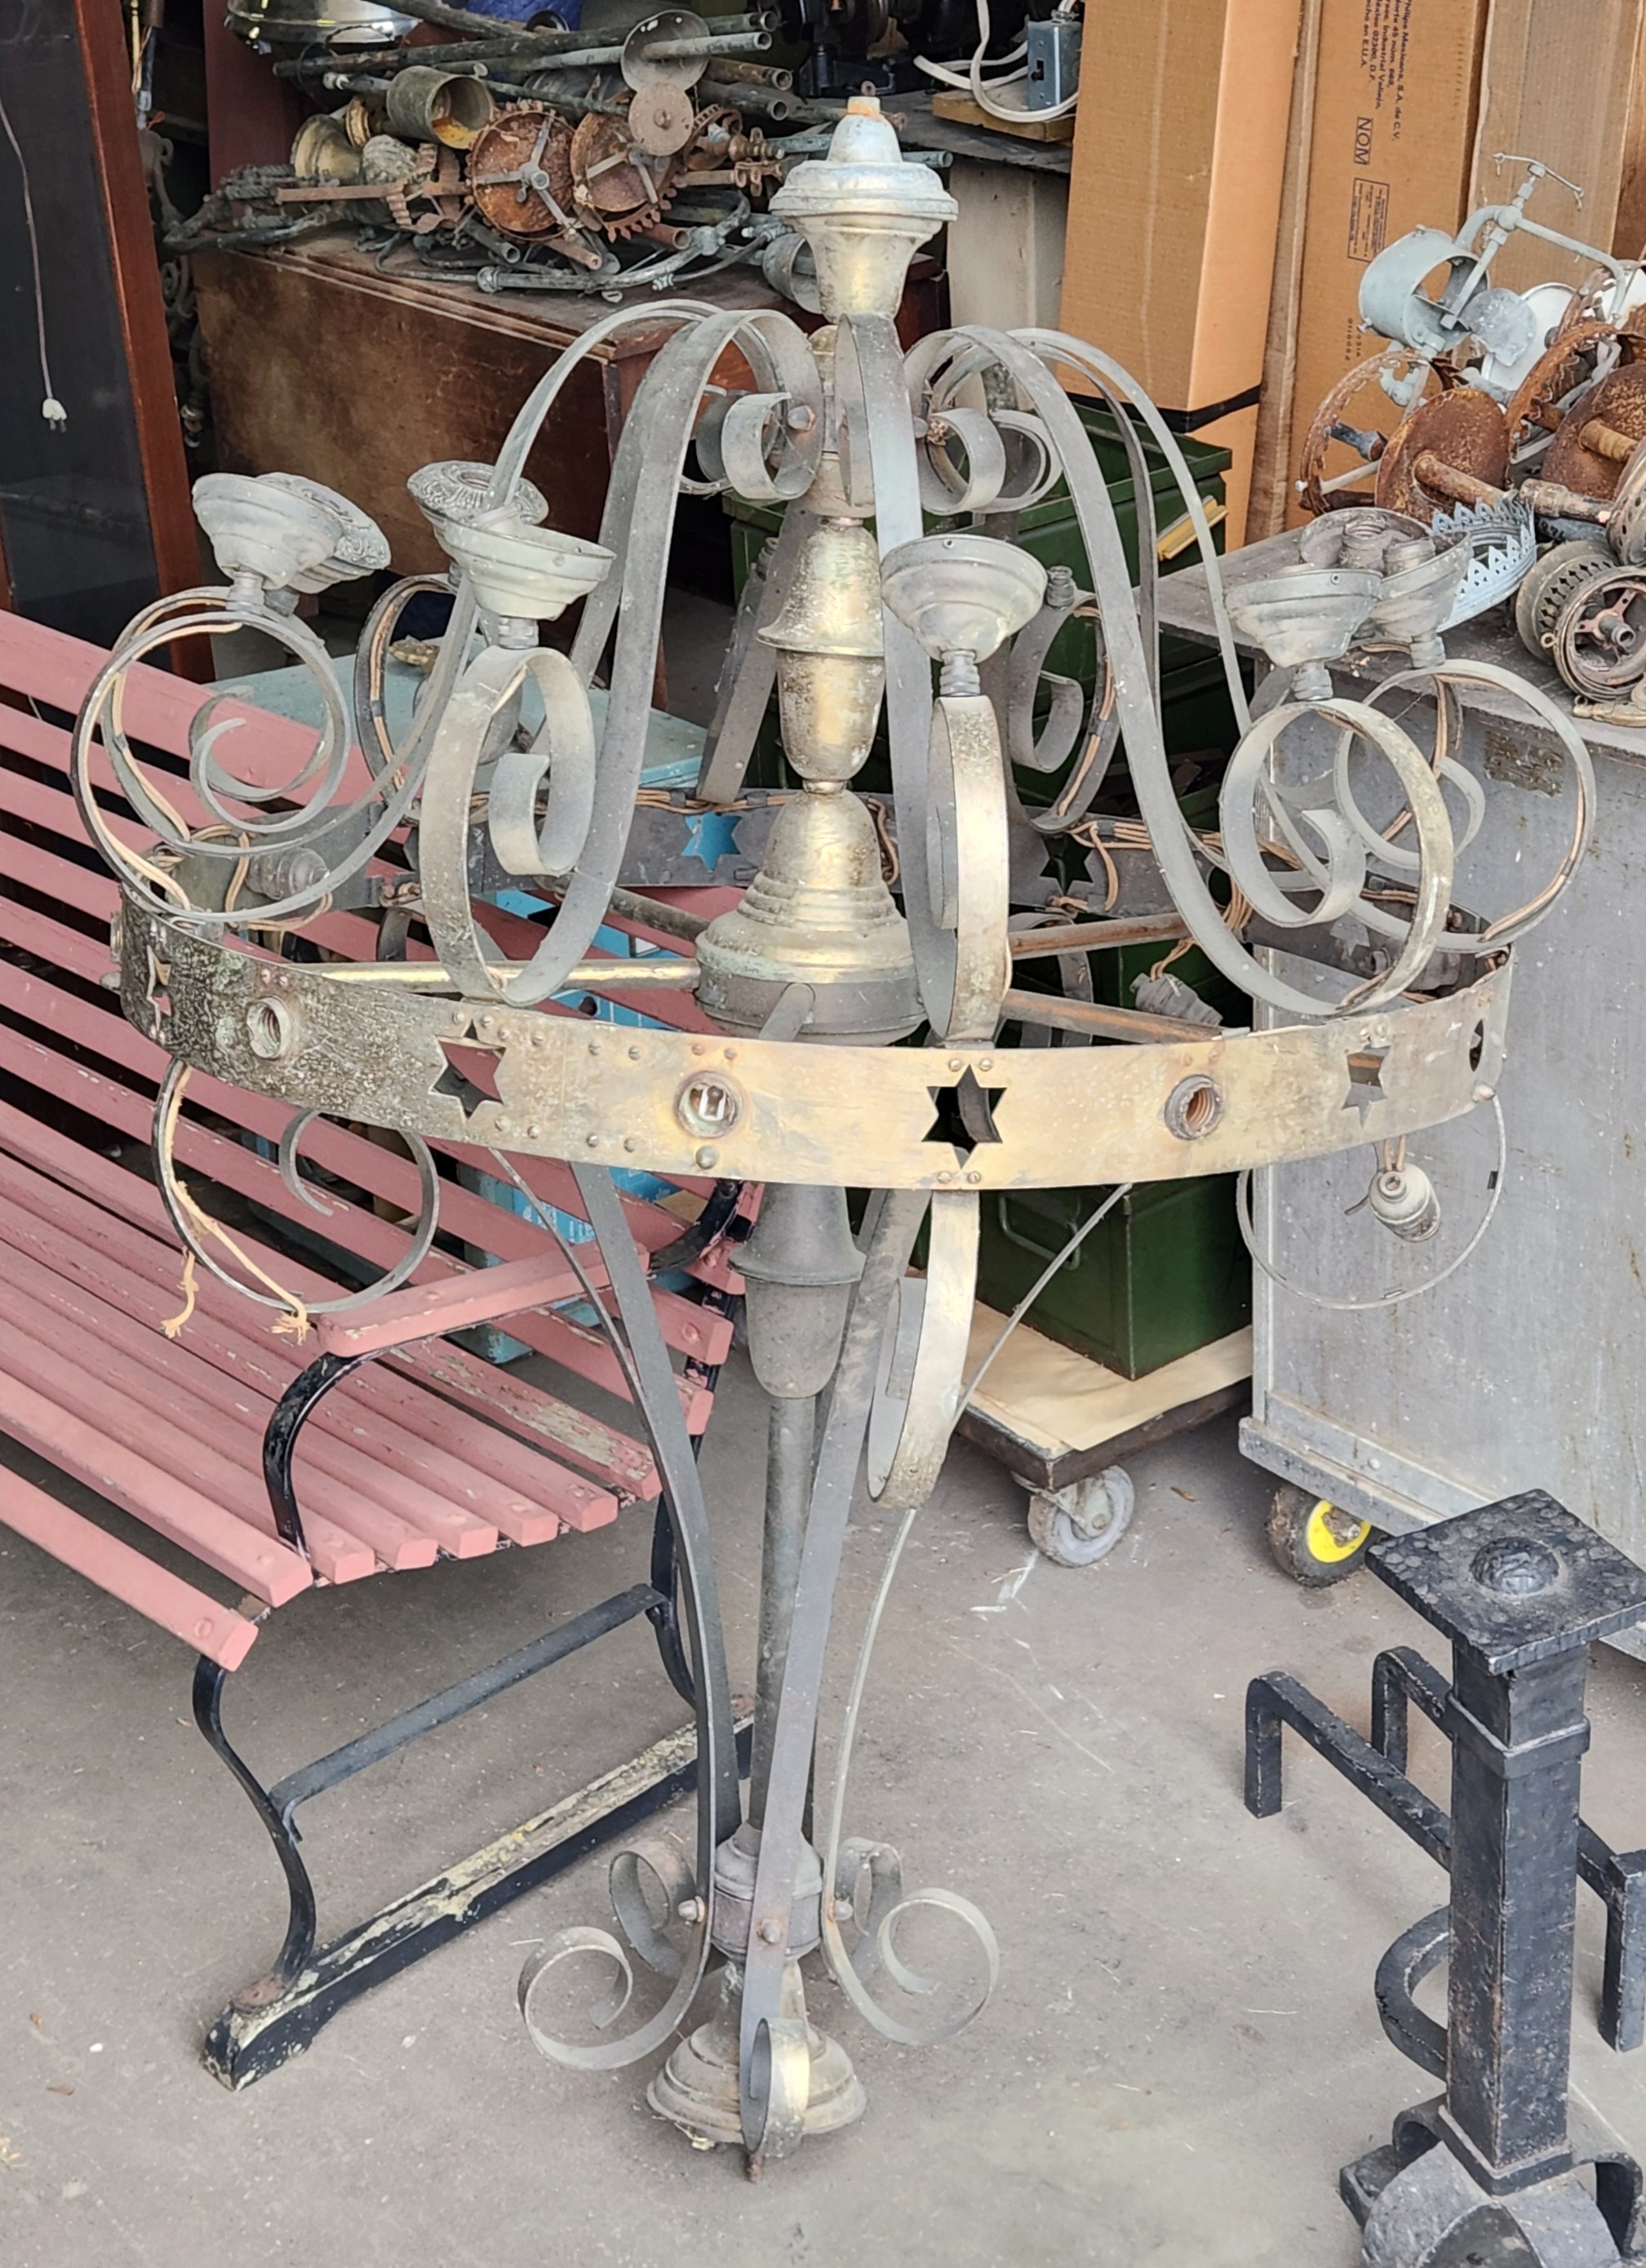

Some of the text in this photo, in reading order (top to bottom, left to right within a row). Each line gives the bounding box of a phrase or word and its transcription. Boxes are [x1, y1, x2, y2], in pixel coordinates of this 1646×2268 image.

[1392, 0, 1401, 23] orte
[1364, 24, 1369, 37] en
[1379, 25, 1389, 72] Industrial
[1395, 107, 1401, 119] de
[1355, 117, 1372, 166] NOM
[1391, 122, 1400, 141] C.V.
